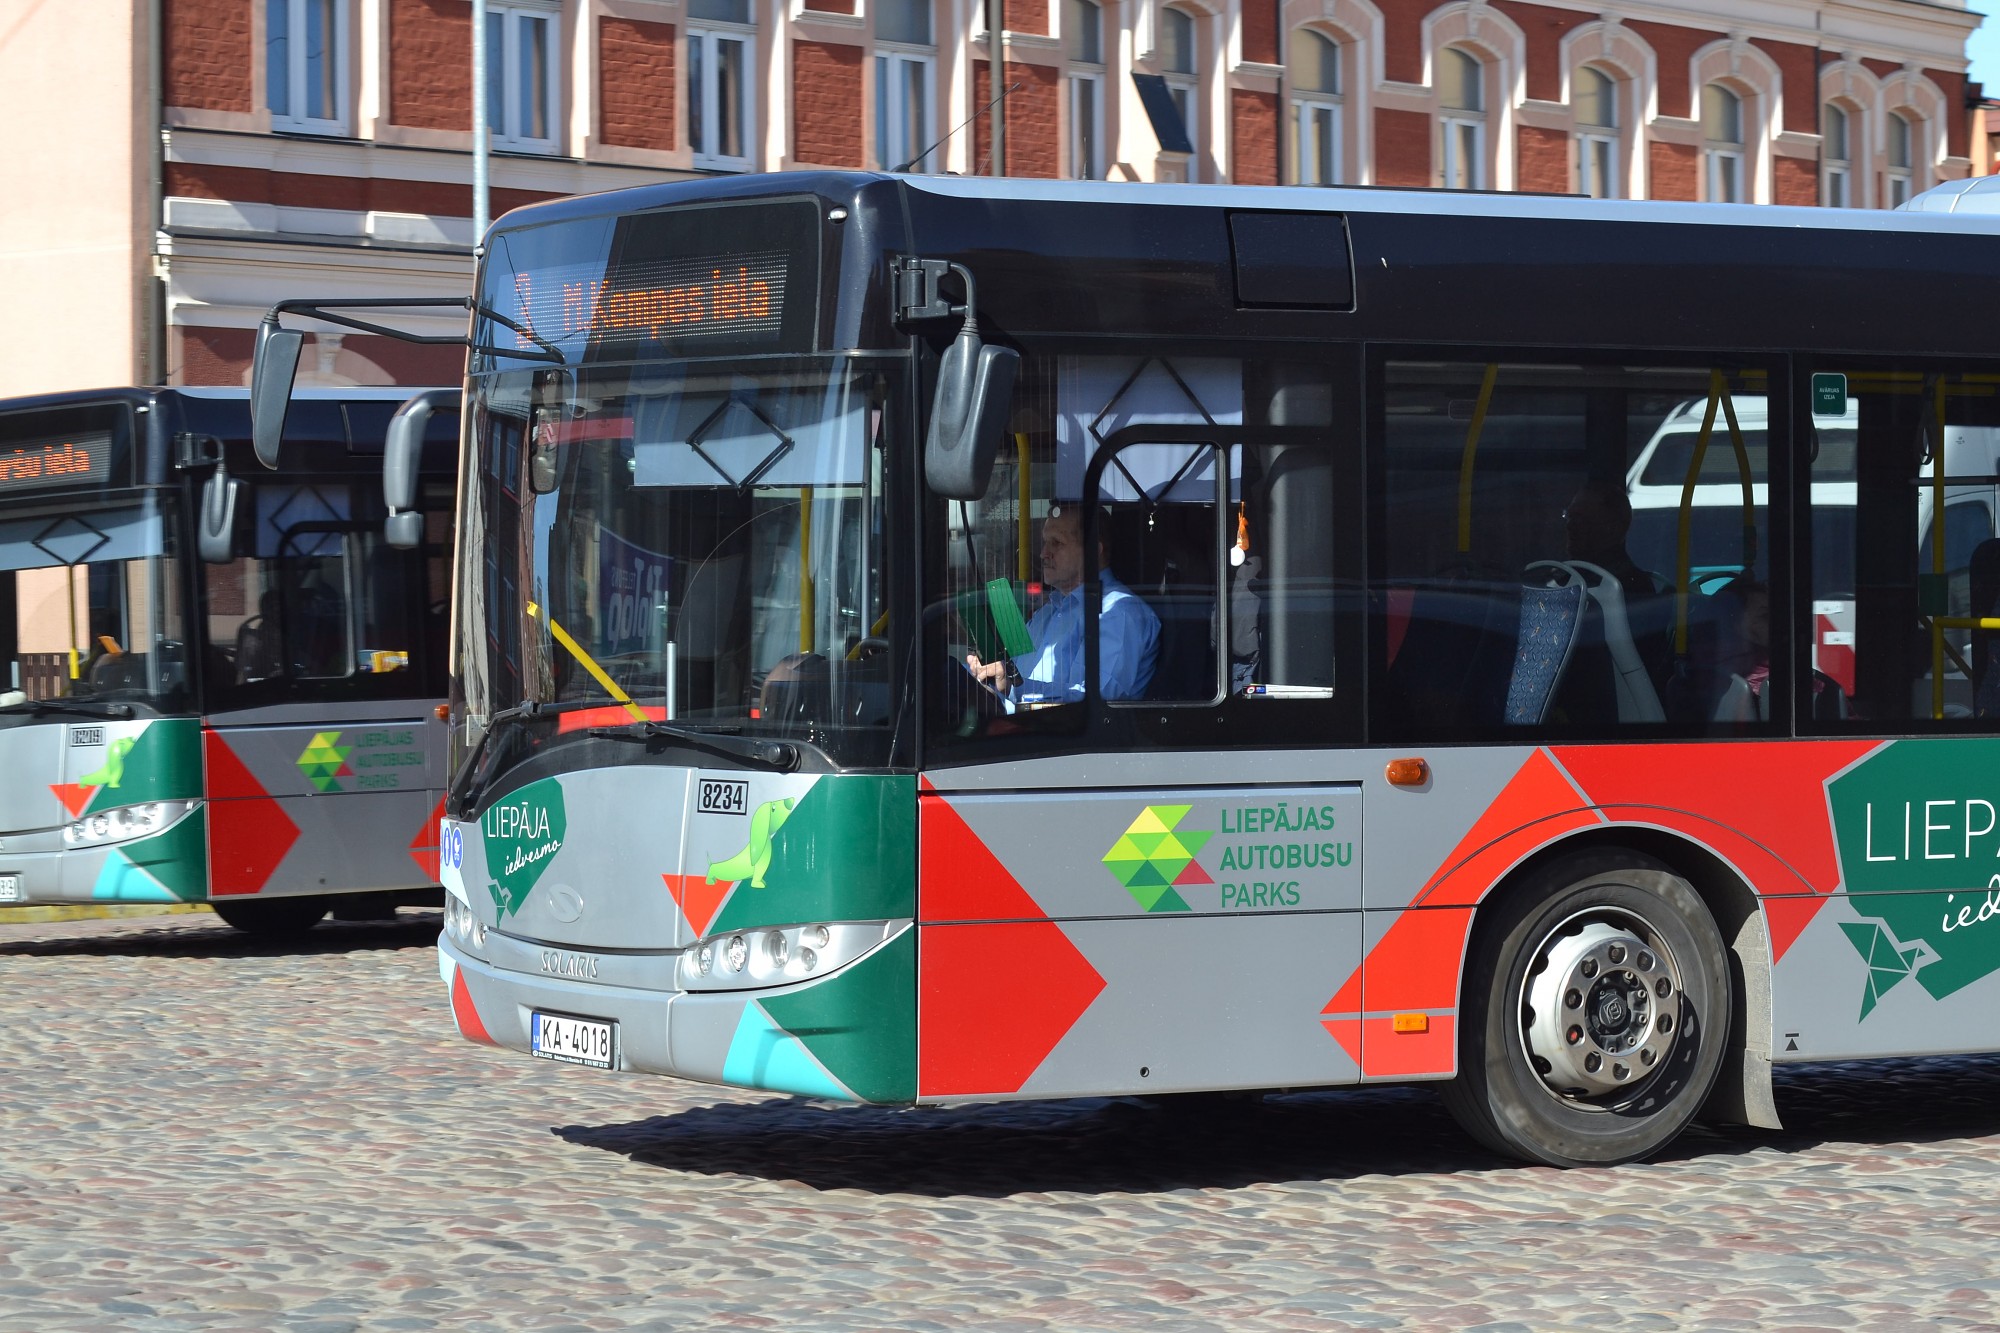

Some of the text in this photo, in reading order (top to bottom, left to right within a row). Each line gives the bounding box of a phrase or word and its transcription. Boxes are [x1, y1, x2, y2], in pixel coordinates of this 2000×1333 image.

[713, 267, 768, 319] iela
[44, 443, 90, 475] iela
[357, 773, 399, 789] PARKS
[703, 783, 742, 810] 8234
[487, 802, 551, 839] LIEPĀJA
[1222, 802, 1335, 834] LIEPĀJAS
[1866, 799, 2000, 861] LIEP
[505, 840, 562, 876] iedvesmo
[1220, 843, 1352, 871] AUTOBUSU
[1221, 881, 1301, 908] PARKS
[541, 950, 599, 979] SOLARIS
[543, 1019, 608, 1057] KA-4018
